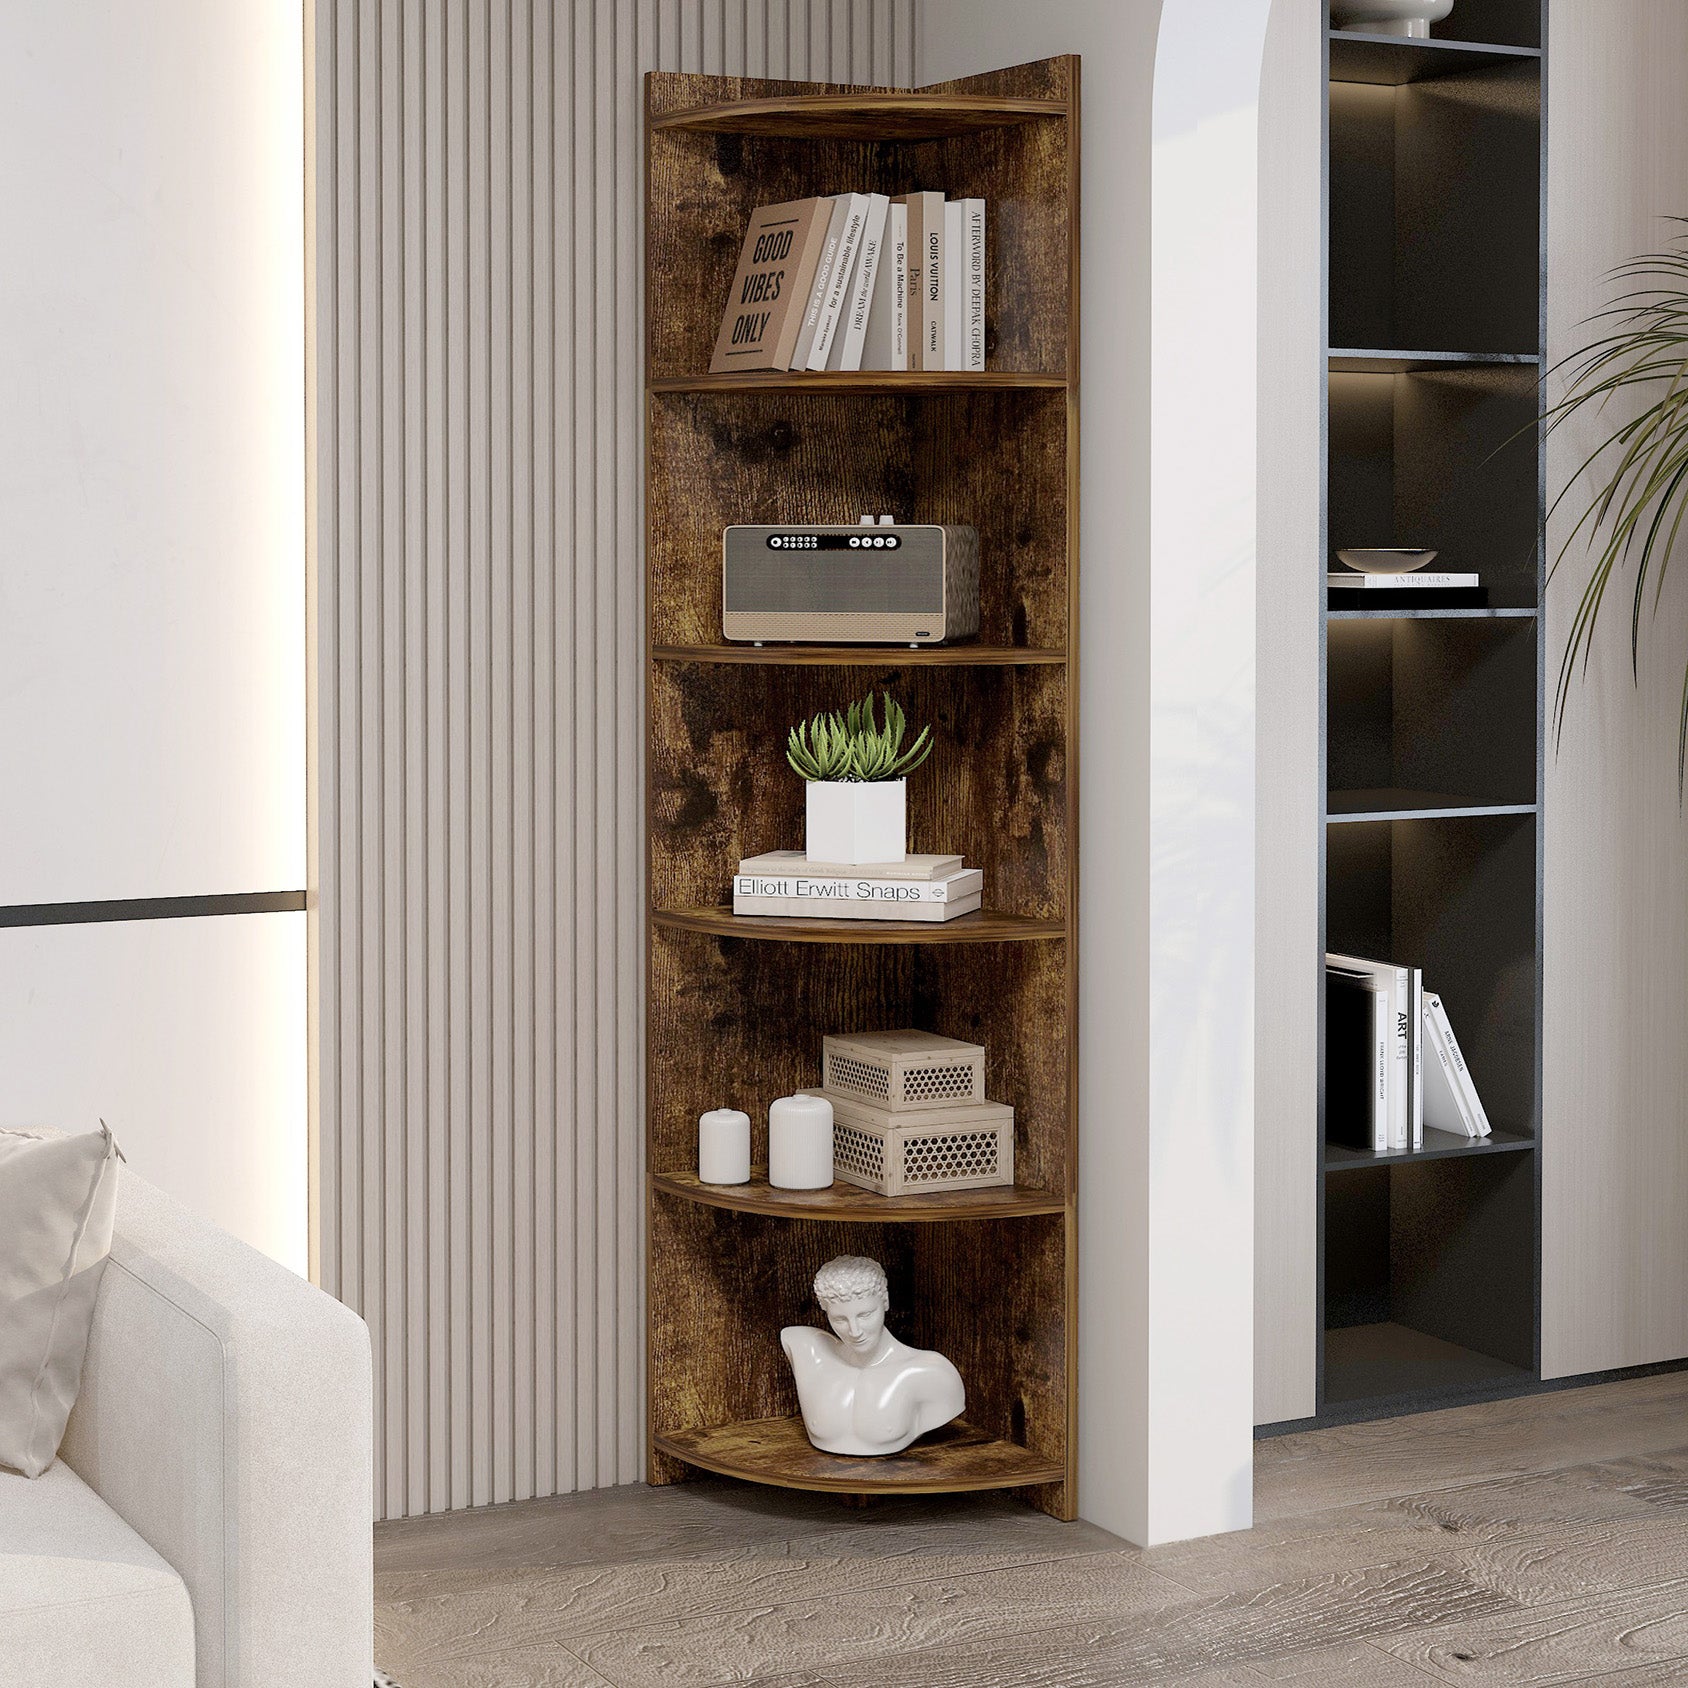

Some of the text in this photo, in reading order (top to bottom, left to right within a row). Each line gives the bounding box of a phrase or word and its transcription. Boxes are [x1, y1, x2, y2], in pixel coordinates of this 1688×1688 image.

[752, 230, 794, 264] GOOD
[829, 297, 838, 309] for
[835, 245, 852, 290] sustainable
[846, 214, 861, 244] lifestyle
[865, 240, 877, 271] AWAKE
[896, 242, 904, 251] To
[896, 254, 904, 264] Be
[808, 308, 819, 327] THIS
[818, 264, 830, 290] GOOD
[826, 237, 838, 264] GUIDE
[863, 269, 871, 288] world
[910, 268, 921, 296] Paris
[930, 232, 939, 301] LOUIS VUITTON
[740, 270, 785, 305] VIBES
[971, 211, 981, 367] AFTERWORD BY DEEPAK CHOPRA
[731, 312, 771, 345] ONLY
[854, 298, 867, 331] DREAM
[1395, 576, 1450, 584] ANTIQUAIRES
[739, 879, 921, 901] Elliott Erwitt Snaps
[1398, 1012, 1407, 1039] ART
